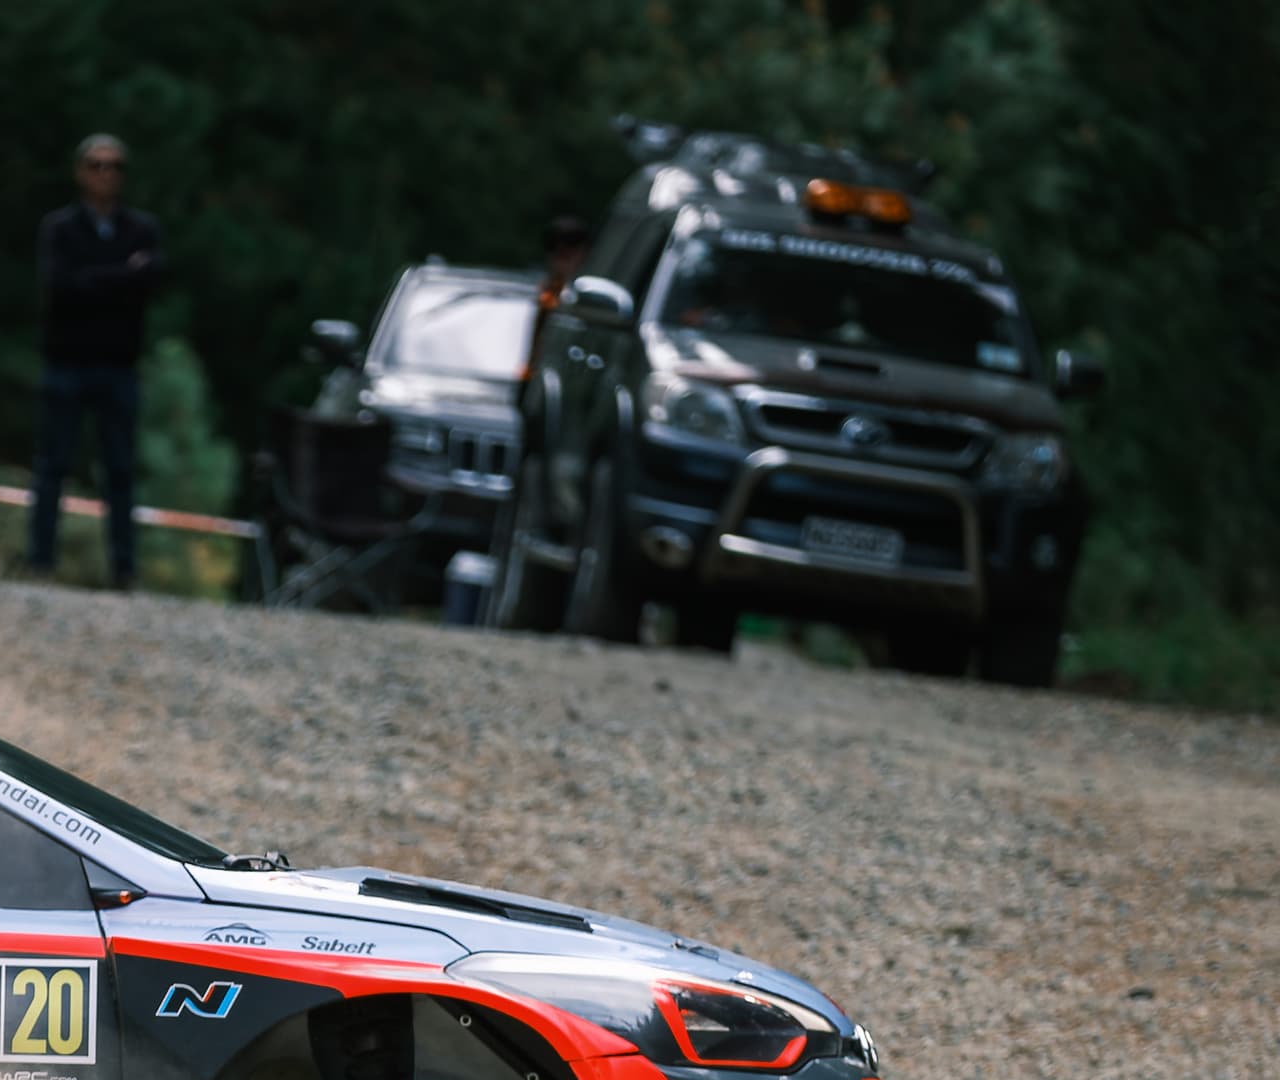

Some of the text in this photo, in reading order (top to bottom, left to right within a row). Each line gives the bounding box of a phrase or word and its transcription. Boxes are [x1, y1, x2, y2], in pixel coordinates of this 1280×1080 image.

[204, 933, 266, 946] AMG
[301, 935, 377, 955] Sabelt
[11, 968, 84, 1055] 20
